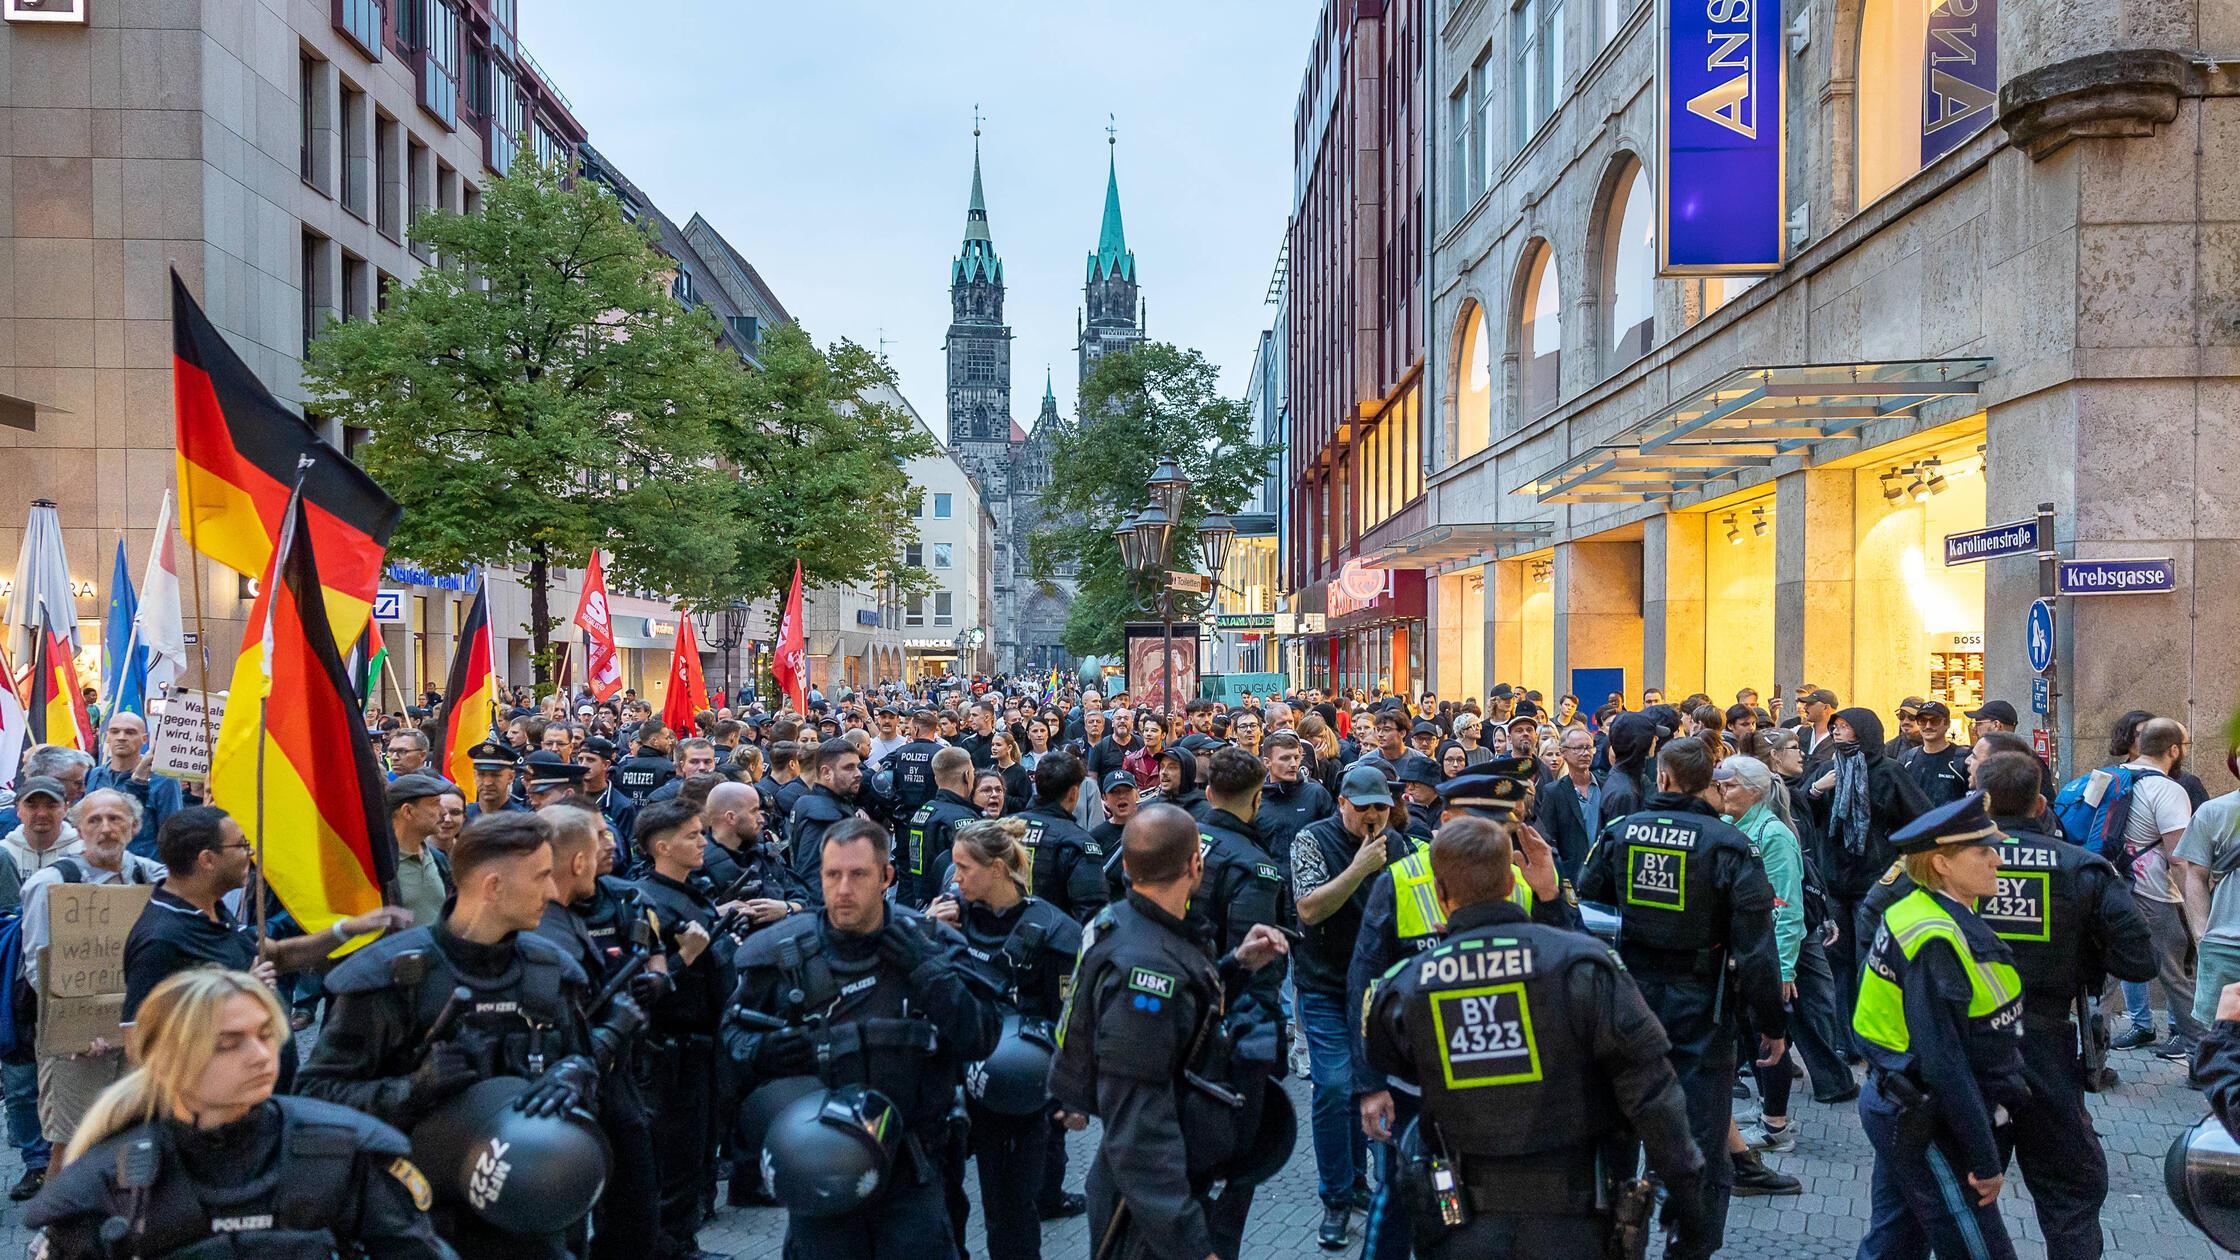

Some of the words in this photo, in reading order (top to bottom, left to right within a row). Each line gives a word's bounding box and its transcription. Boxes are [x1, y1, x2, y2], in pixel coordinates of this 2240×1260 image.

[1949, 527, 2031, 557] Karolinenstraße
[1177, 576, 1201, 588] Toiletten
[2067, 567, 2165, 588] Krebsgasse
[1217, 616, 1275, 627] SALAMANDER
[903, 639, 952, 648] ARBUCKS
[1954, 636, 1981, 645] BOSS
[1234, 683, 1278, 694] DOUGLAS
[164, 714, 197, 728] gegen
[166, 729, 192, 742] wird,
[171, 744, 187, 755] ein
[901, 752, 929, 762] POLIZEI
[169, 758, 188, 770] das
[909, 766, 919, 774] BY
[622, 772, 654, 785] POLIZEI
[632, 790, 644, 799] BY
[1625, 824, 1697, 847] POLIZEI
[1644, 852, 1669, 871] BY
[2000, 846, 2058, 867] LIZEI
[1260, 866, 1276, 877] USK
[1637, 870, 1675, 889] 4321
[1996, 878, 2027, 898] BY
[64, 890, 111, 930] afd
[1985, 896, 2036, 917] 4321
[1420, 948, 1533, 985] POLIZEI
[841, 975, 877, 997] POLIZEI
[1136, 972, 1169, 993] USK
[476, 1001, 518, 1013] POLIZEI
[1461, 995, 1498, 1026] BY
[1450, 1020, 1523, 1054] 4323
[212, 1214, 273, 1233] POLIZEI
